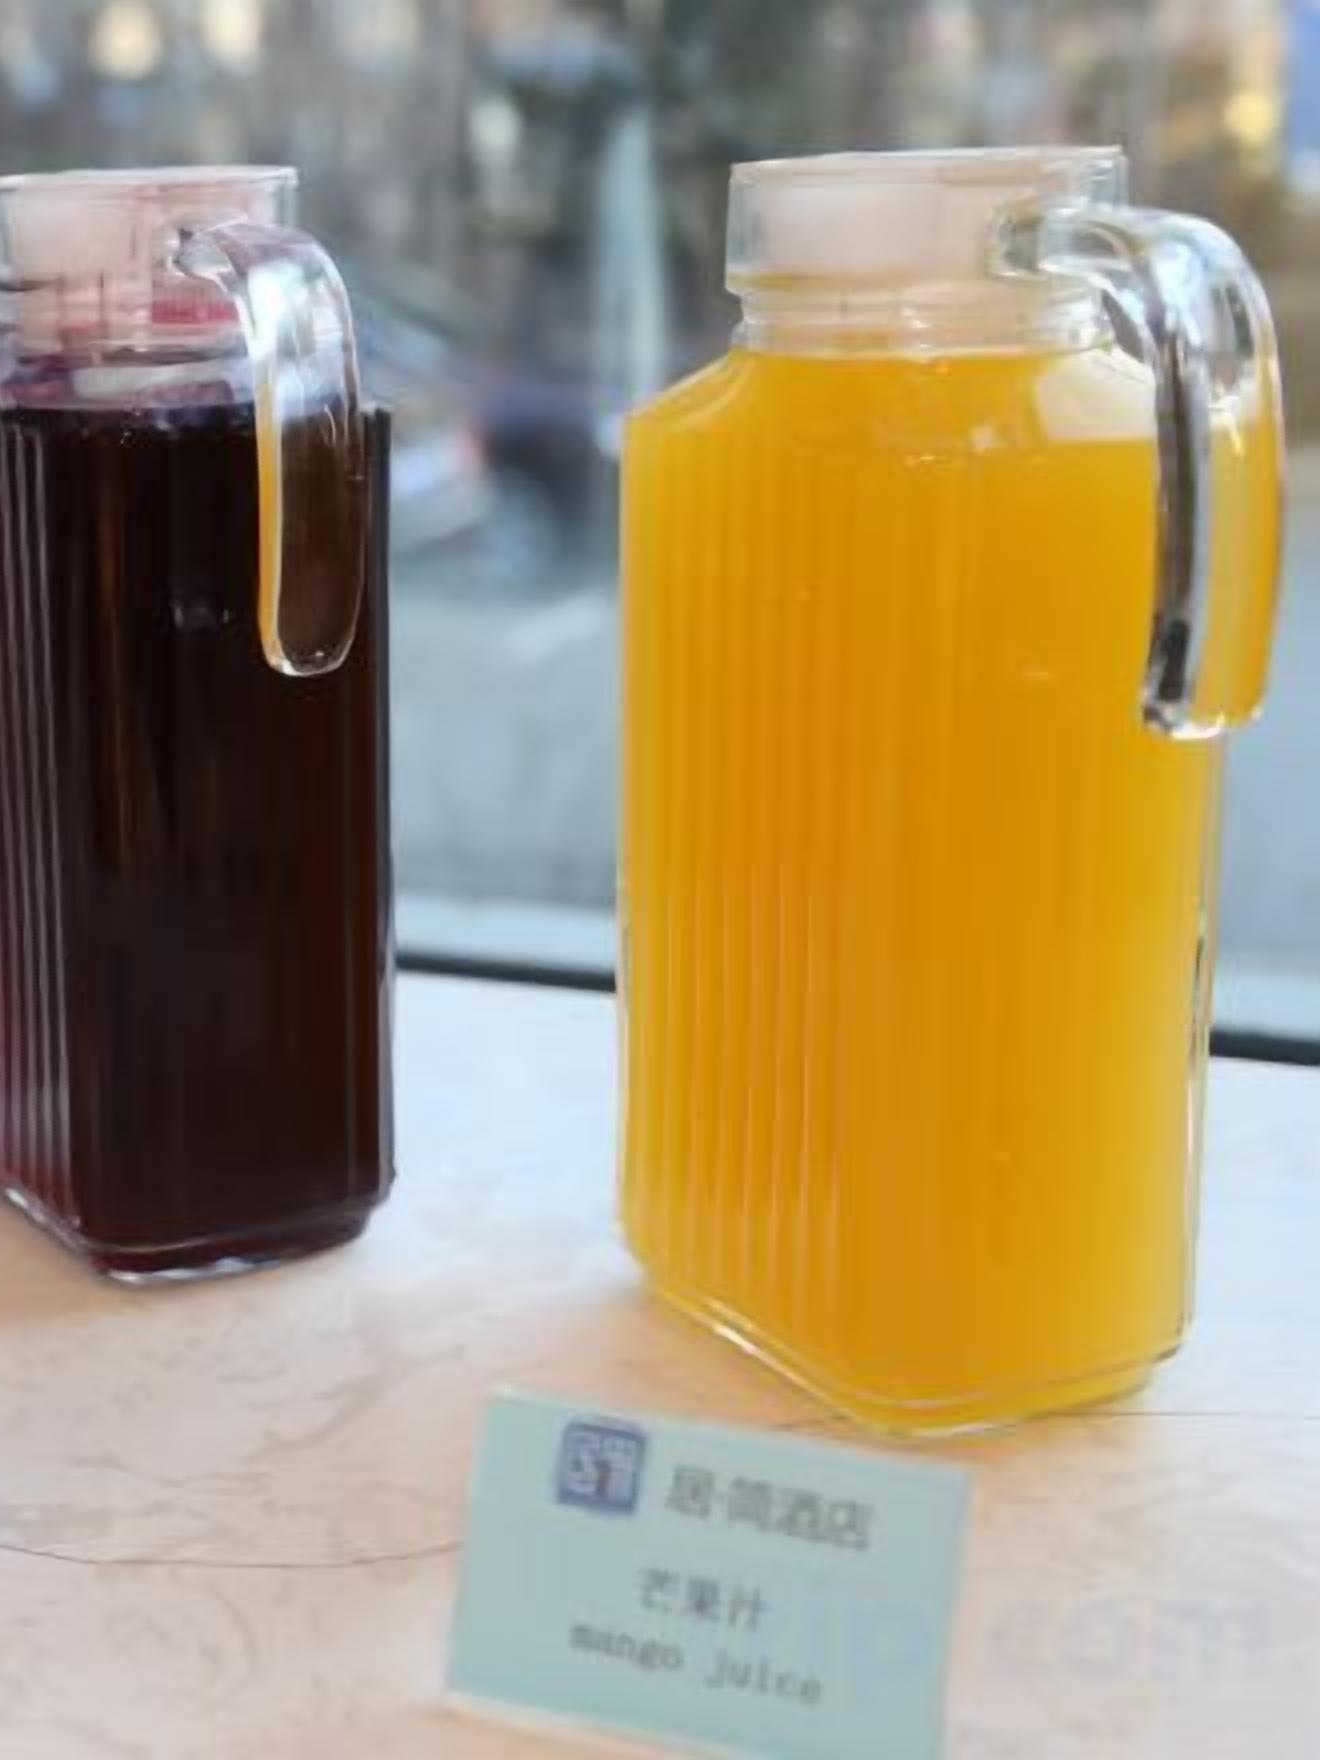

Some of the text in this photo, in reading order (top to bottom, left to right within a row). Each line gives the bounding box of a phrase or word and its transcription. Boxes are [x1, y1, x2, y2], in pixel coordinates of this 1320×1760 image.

[635, 1566, 770, 1630] 芒果汁
[567, 1621, 825, 1706] mango juice
